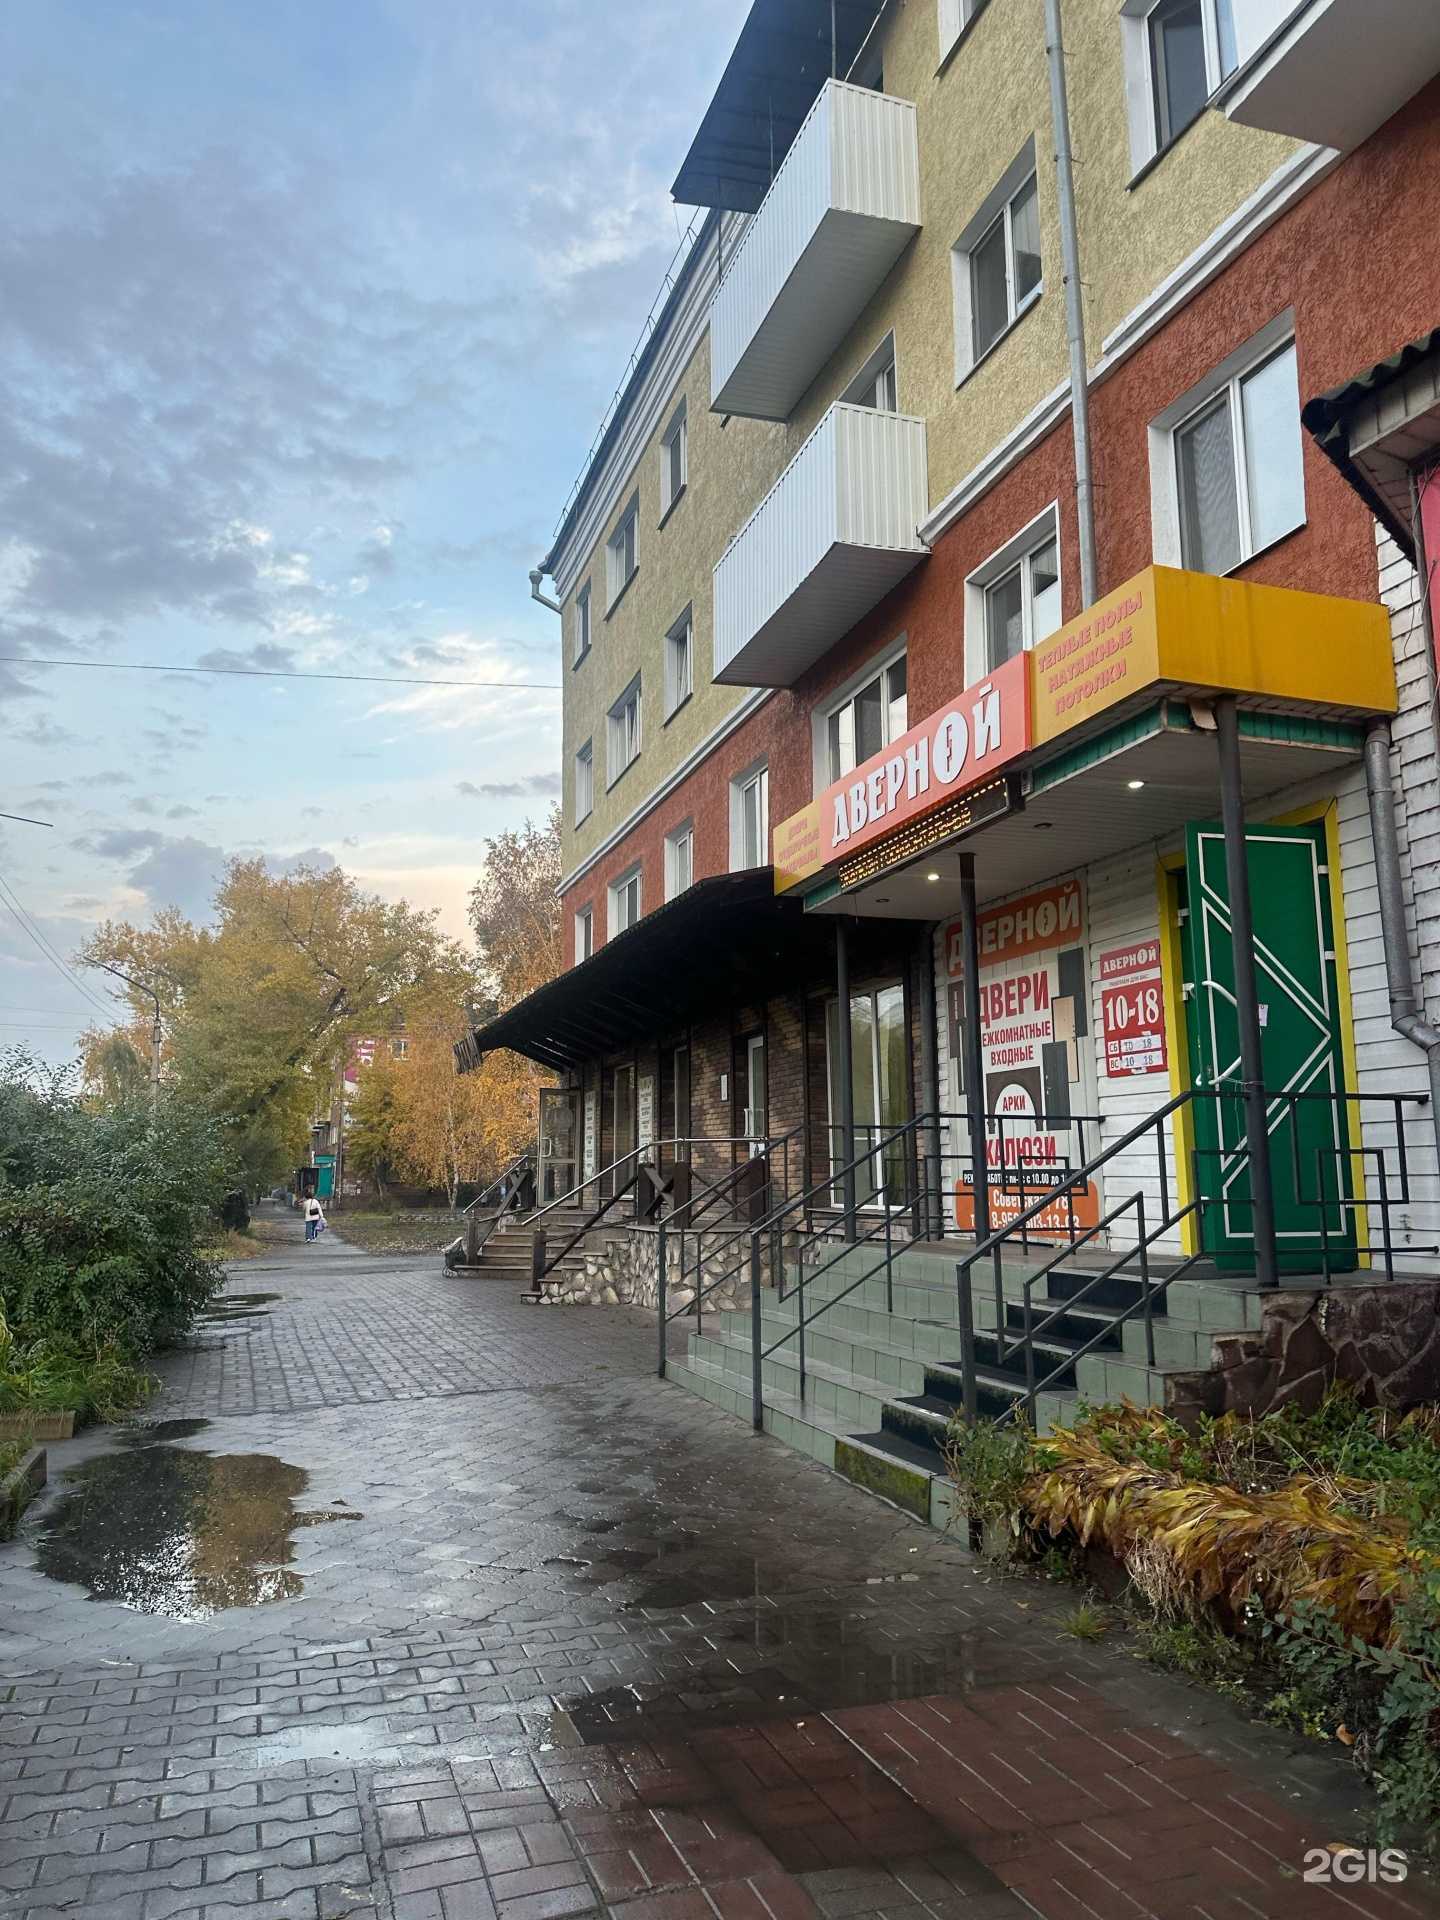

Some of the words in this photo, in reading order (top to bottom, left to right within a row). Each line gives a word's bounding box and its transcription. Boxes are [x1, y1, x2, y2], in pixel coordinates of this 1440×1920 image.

[1039, 626, 1091, 673] ТЕПЛЫЕ
[1094, 591, 1143, 637] ПОЛЫ
[1049, 626, 1133, 693] НАТЯЖНЫЕ
[1055, 658, 1127, 716] ПОТОЛКИ
[832, 683, 1001, 848] ДВЕРНОЙ
[948, 882, 1080, 972] ДЕРНОЙ
[1103, 946, 1157, 973] ДВЕРНОЙ
[980, 971, 1049, 1029] ДВЕРИ
[1105, 988, 1160, 1031] 10-18
[982, 1021, 1051, 1047] ЕЖКОМНАТНЫЕ
[991, 1045, 1034, 1066] ВХОДНЫЕ
[1109, 1042, 1118, 1052] СБ
[1110, 1059, 1119, 1069] ВС
[1002, 1095, 1026, 1111] АРКИ
